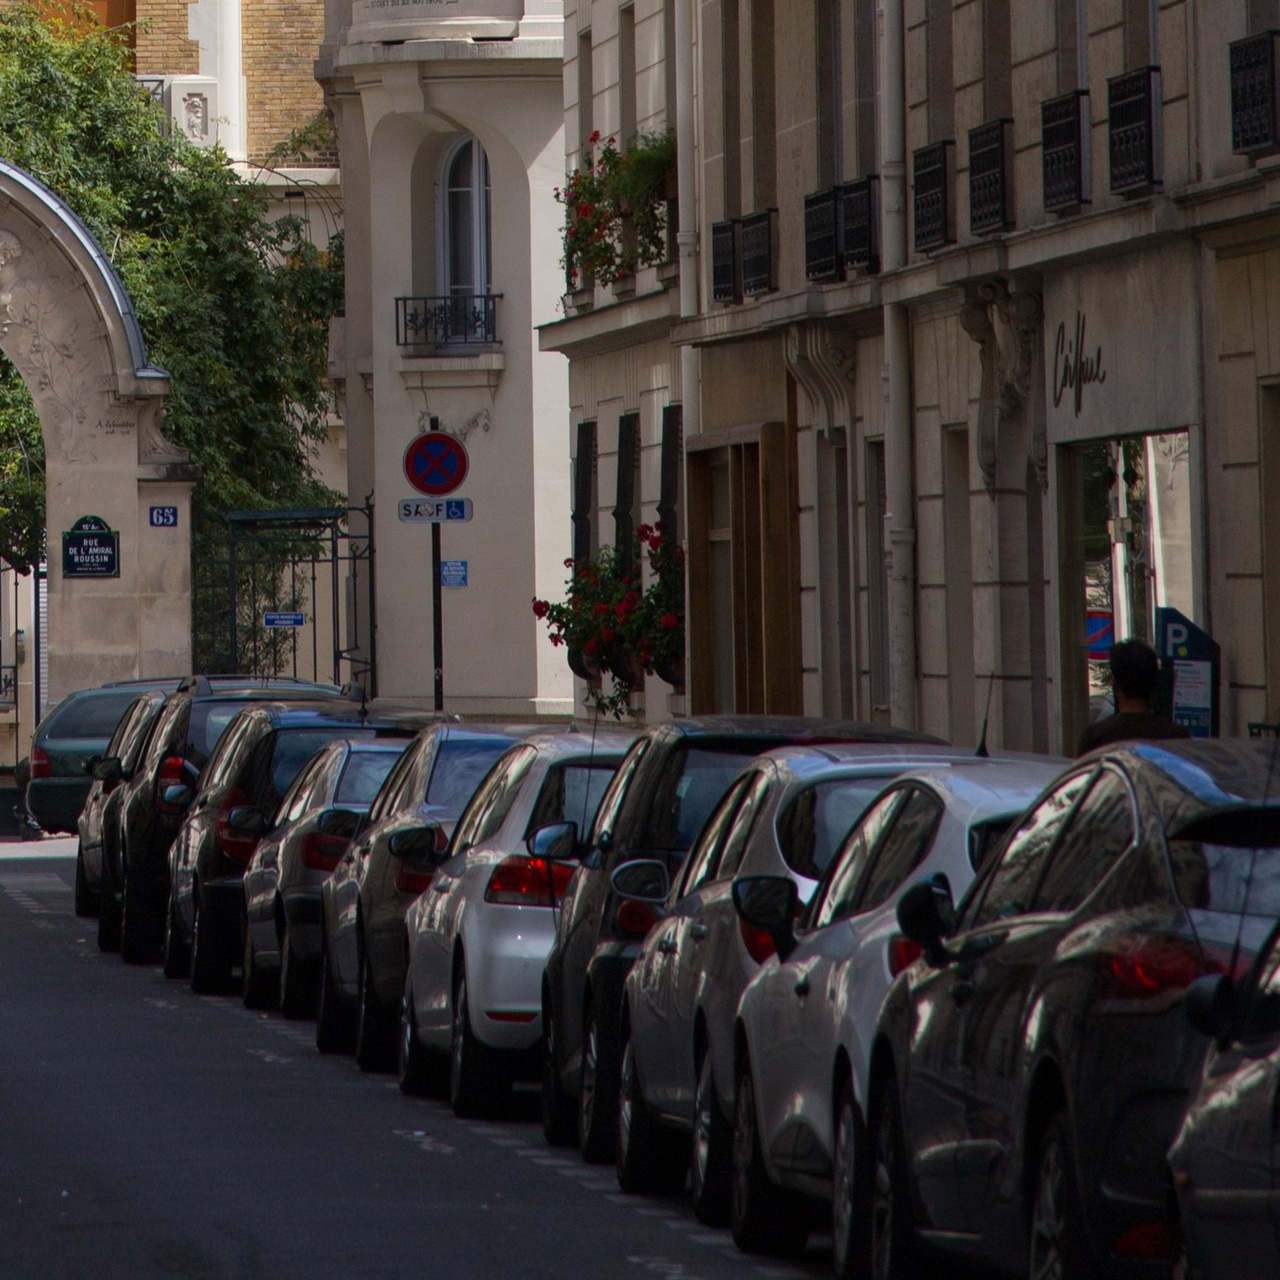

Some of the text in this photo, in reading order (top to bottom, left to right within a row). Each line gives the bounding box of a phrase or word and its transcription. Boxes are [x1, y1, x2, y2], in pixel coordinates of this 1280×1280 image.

[152, 508, 174, 525] 65
[83, 539, 98, 547] RUE
[69, 547, 77, 555] DE
[74, 555, 109, 563] ROUSSIN
[1166, 622, 1189, 657] P
